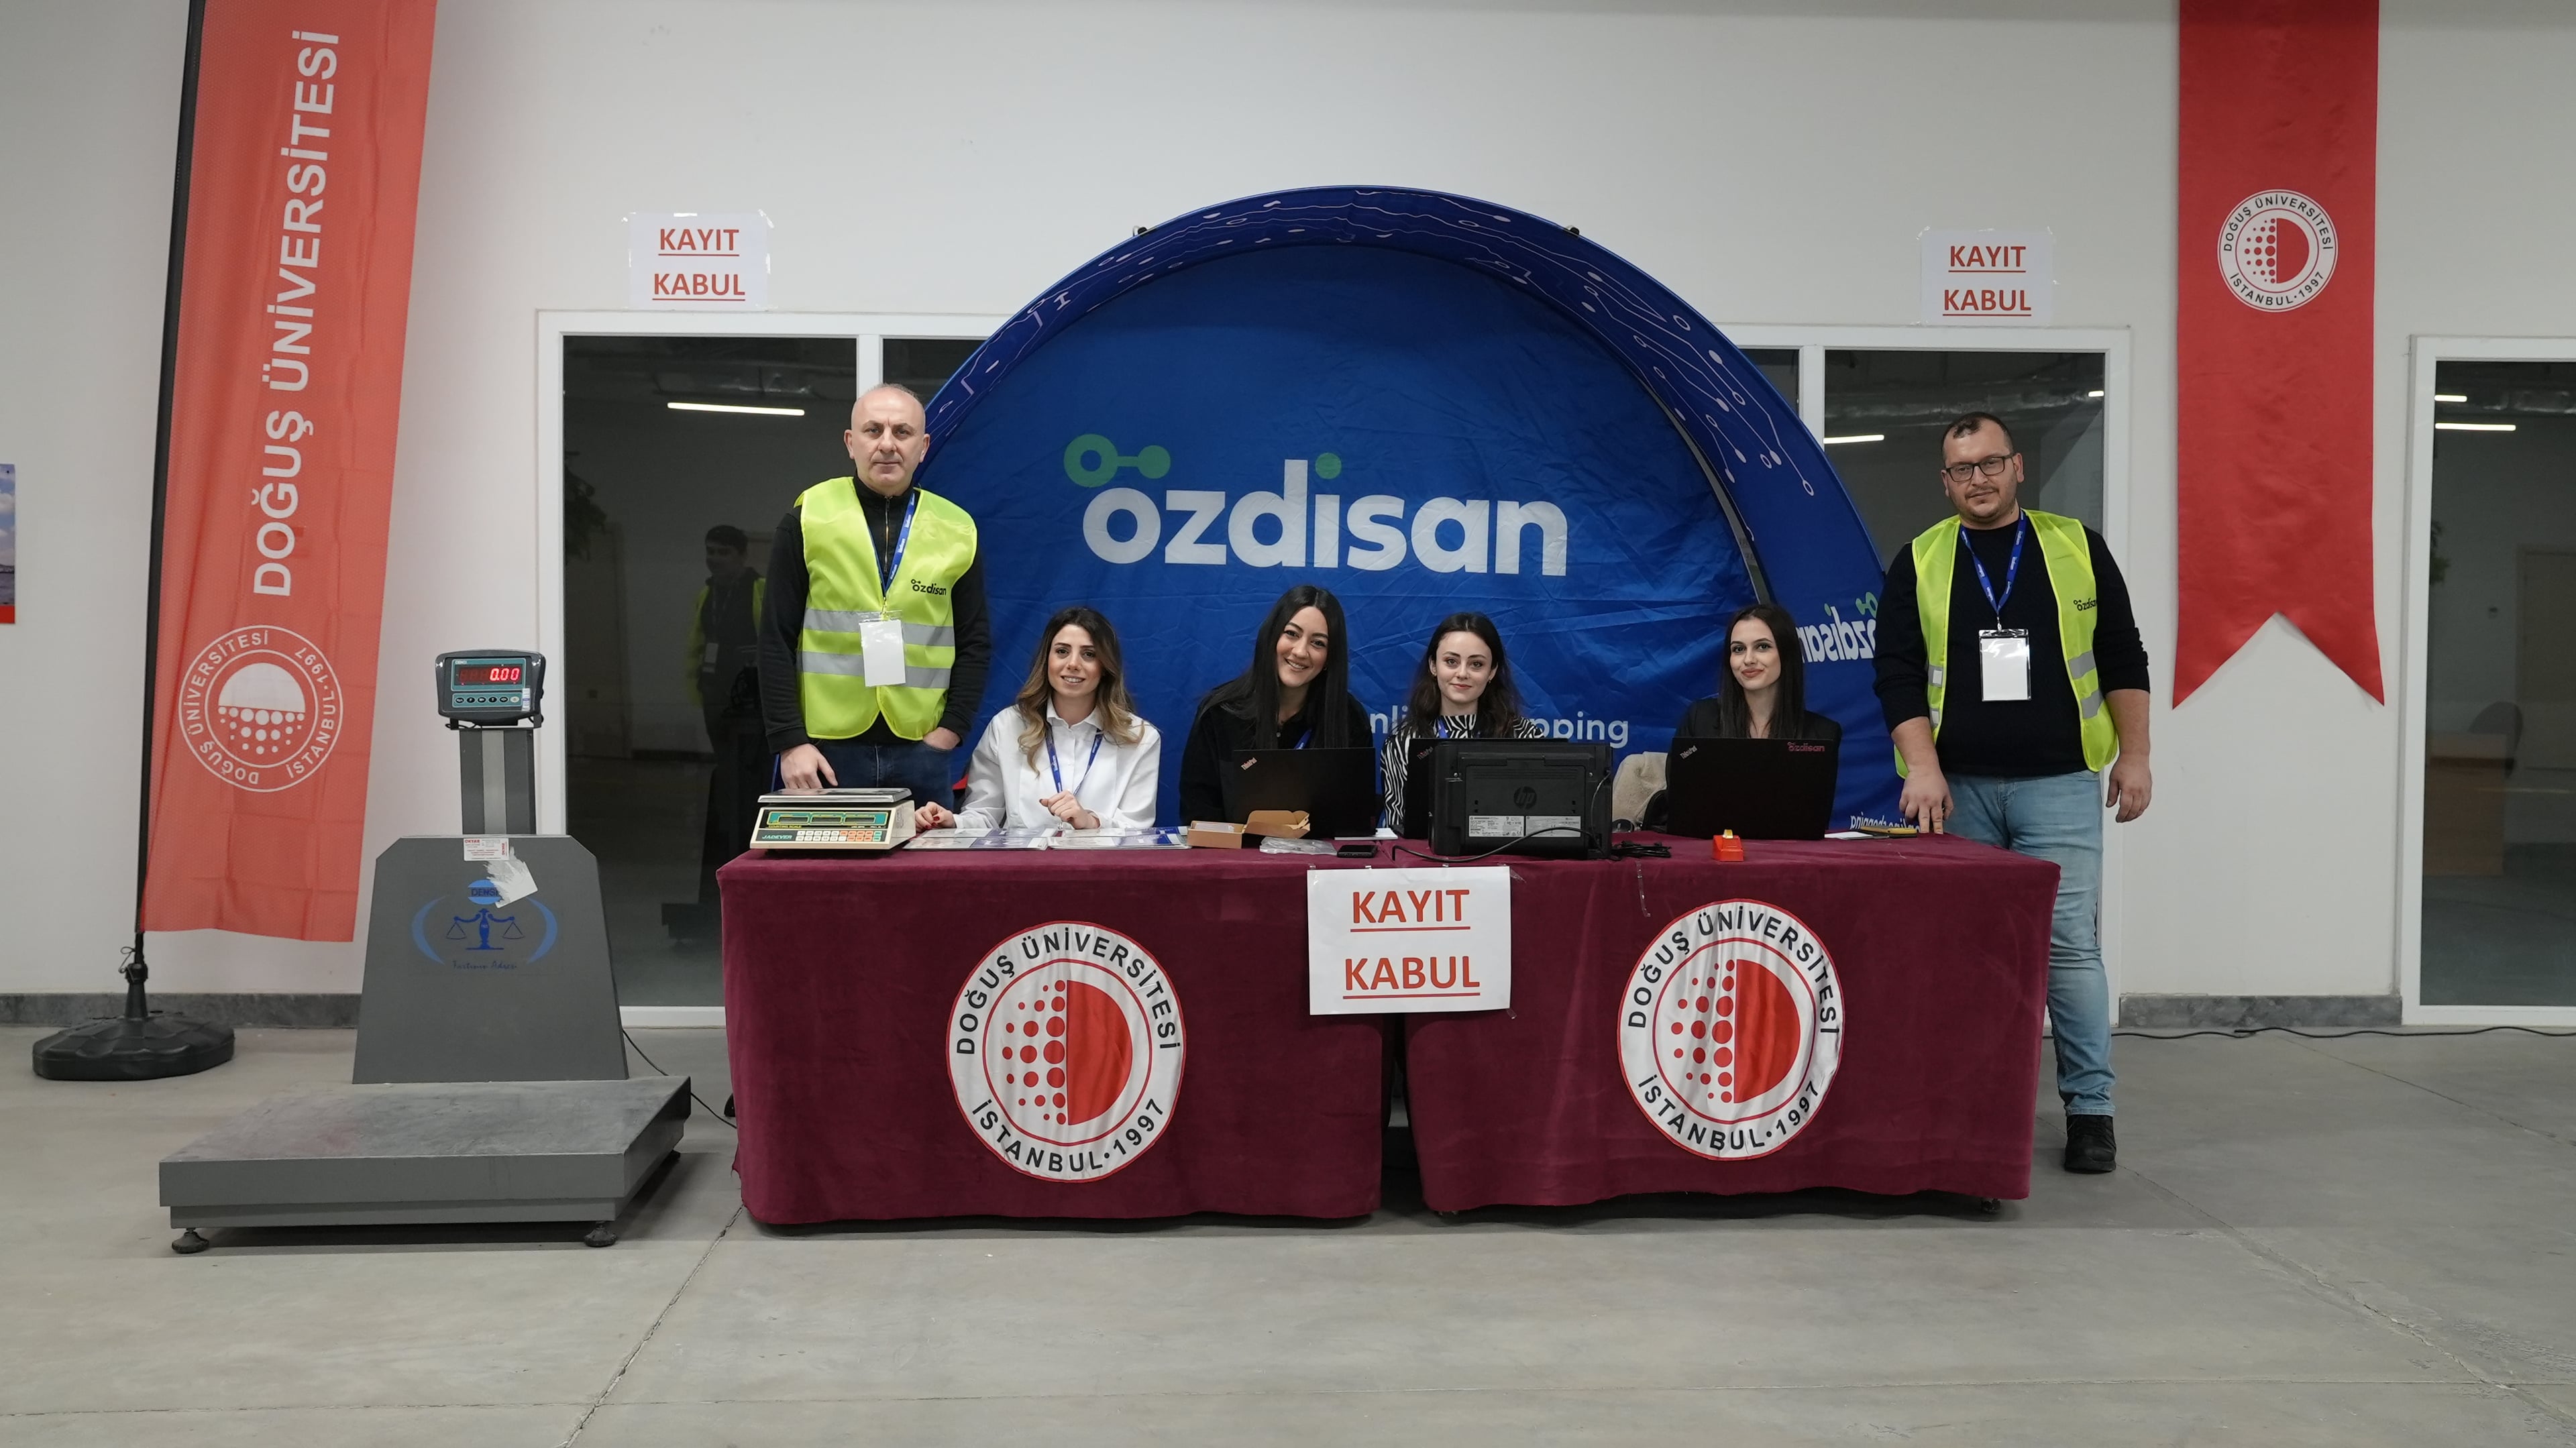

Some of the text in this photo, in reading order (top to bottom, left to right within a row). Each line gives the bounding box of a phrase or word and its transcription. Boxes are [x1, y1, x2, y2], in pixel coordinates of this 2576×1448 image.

[660, 229, 739, 251] KAYIT
[2224, 194, 2333, 252] DOĞUŞ ÜNİVERSİTESİ
[1950, 245, 2026, 267] KAYIT
[654, 274, 745, 296] KABUL
[1944, 289, 2031, 311] KABUL
[251, 30, 340, 596] DOĞUŞ ÜNİVERSİTESİ
[1064, 434, 1568, 577] özdisan
[911, 579, 947, 596] özdisan
[490, 667, 521, 681] 0.00
[184, 630, 268, 786] DOĞUŞ ÜNİVERSİTESİ
[1787, 741, 1825, 752] özdisan
[1353, 889, 1470, 924] KAYIT
[957, 928, 1181, 1054] DOĞUŞ ÜNİVERSİTESİ
[1345, 956, 1480, 991] KABUL
[1628, 931, 1690, 1027] DOĞUŞ
